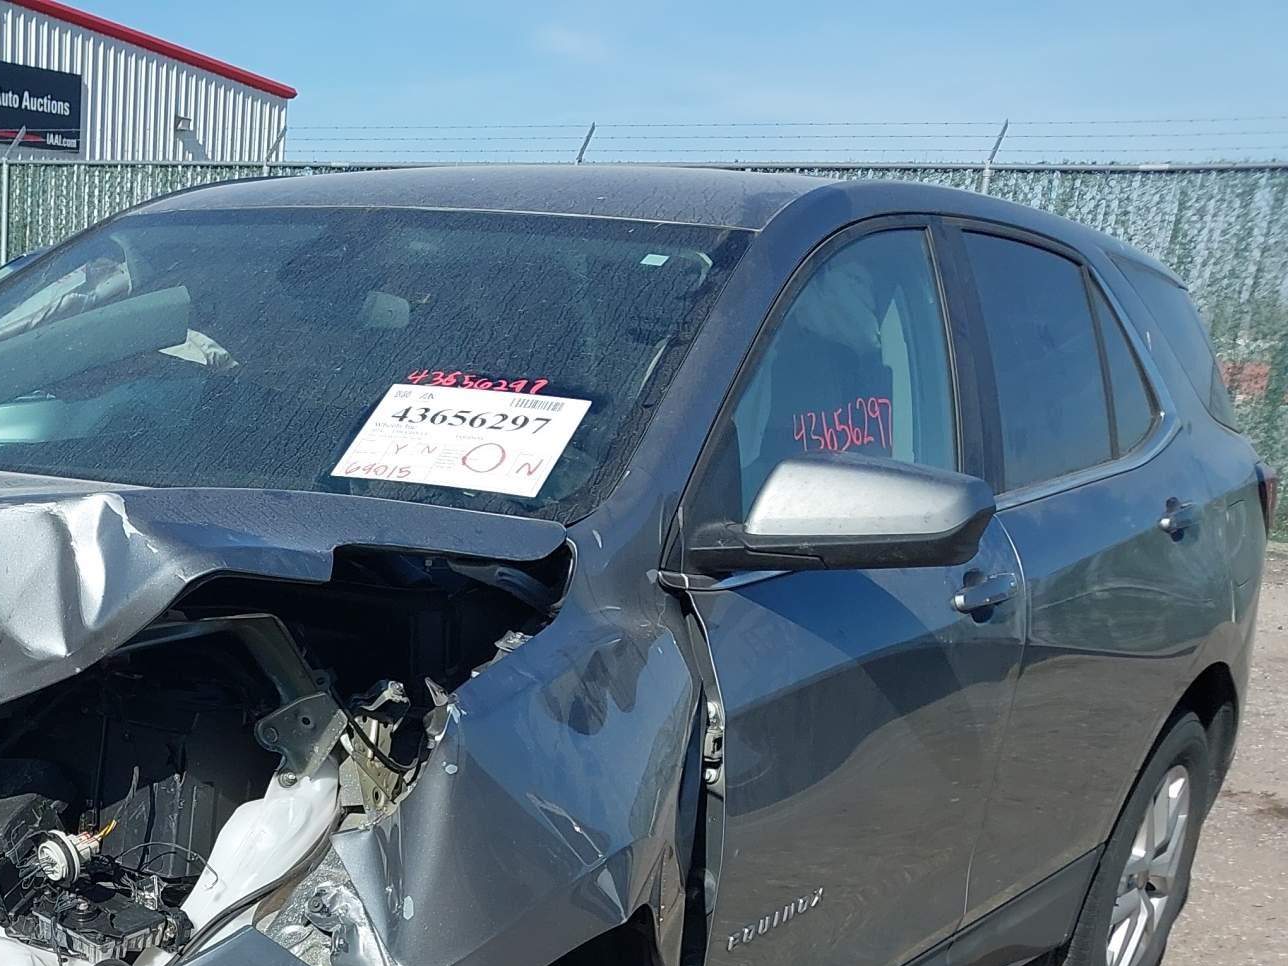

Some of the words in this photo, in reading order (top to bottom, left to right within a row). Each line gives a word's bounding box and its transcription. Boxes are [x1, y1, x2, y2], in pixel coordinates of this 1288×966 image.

[21, 90, 70, 116] Auctions
[391, 405, 552, 435] 43656297
[792, 397, 893, 452] 43656297
[515, 458, 544, 477] N
